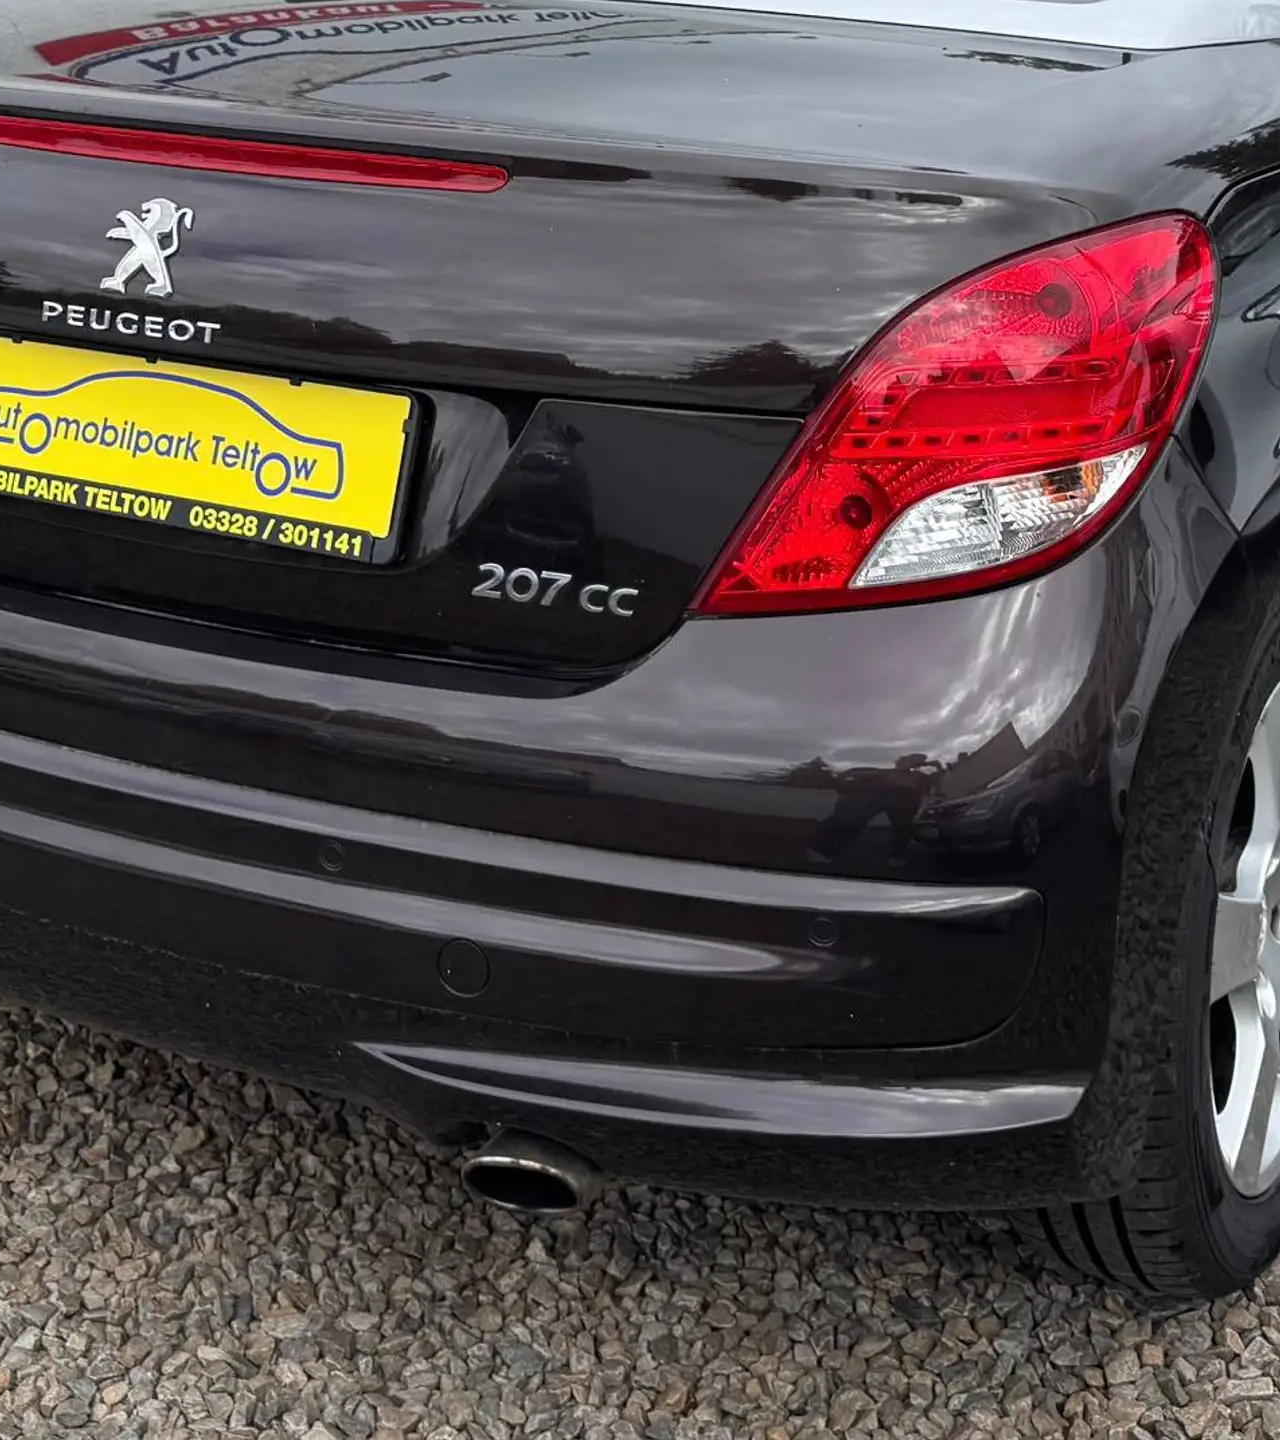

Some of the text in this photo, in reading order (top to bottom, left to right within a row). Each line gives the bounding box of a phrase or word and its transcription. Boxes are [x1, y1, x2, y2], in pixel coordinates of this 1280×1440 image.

[40, 300, 221, 346] PEUGEOT
[210, 435, 318, 498] Teltow
[83, 486, 172, 521] TELTOW
[188, 505, 259, 539] 03328
[262, 517, 274, 540] /
[278, 521, 363, 558] 301141
[470, 561, 574, 605] 207
